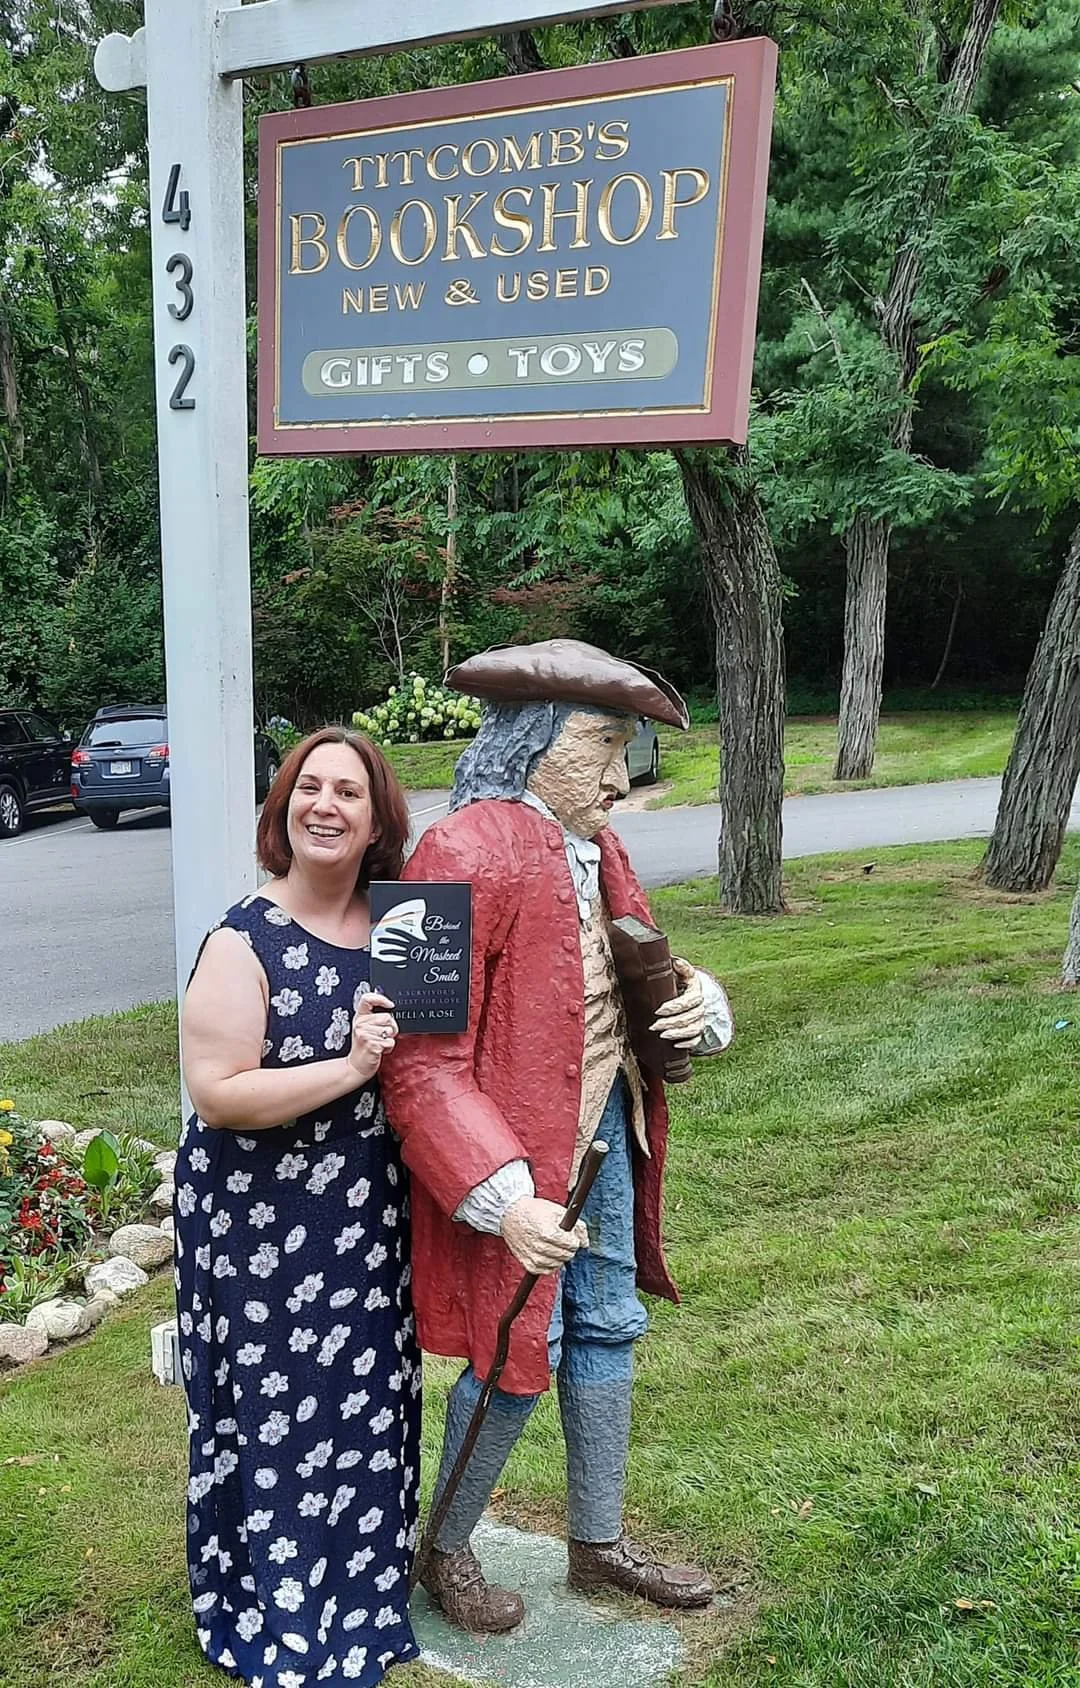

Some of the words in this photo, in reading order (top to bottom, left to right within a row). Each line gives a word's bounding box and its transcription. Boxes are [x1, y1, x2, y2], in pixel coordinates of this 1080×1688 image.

[341, 120, 631, 191] TITCOMB'S
[288, 167, 711, 276] BOOKSHOP
[162, 163, 196, 410] 432
[341, 280, 427, 315] NEW
[444, 279, 480, 306] &
[496, 264, 611, 304] USED
[319, 351, 450, 389] GIFTS
[508, 339, 647, 378] TOYS
[425, 915, 461, 931] Behind
[438, 935, 450, 945] the
[410, 945, 463, 963] Masked
[423, 966, 460, 984] Smile
[428, 1009, 455, 1018] ROSE
